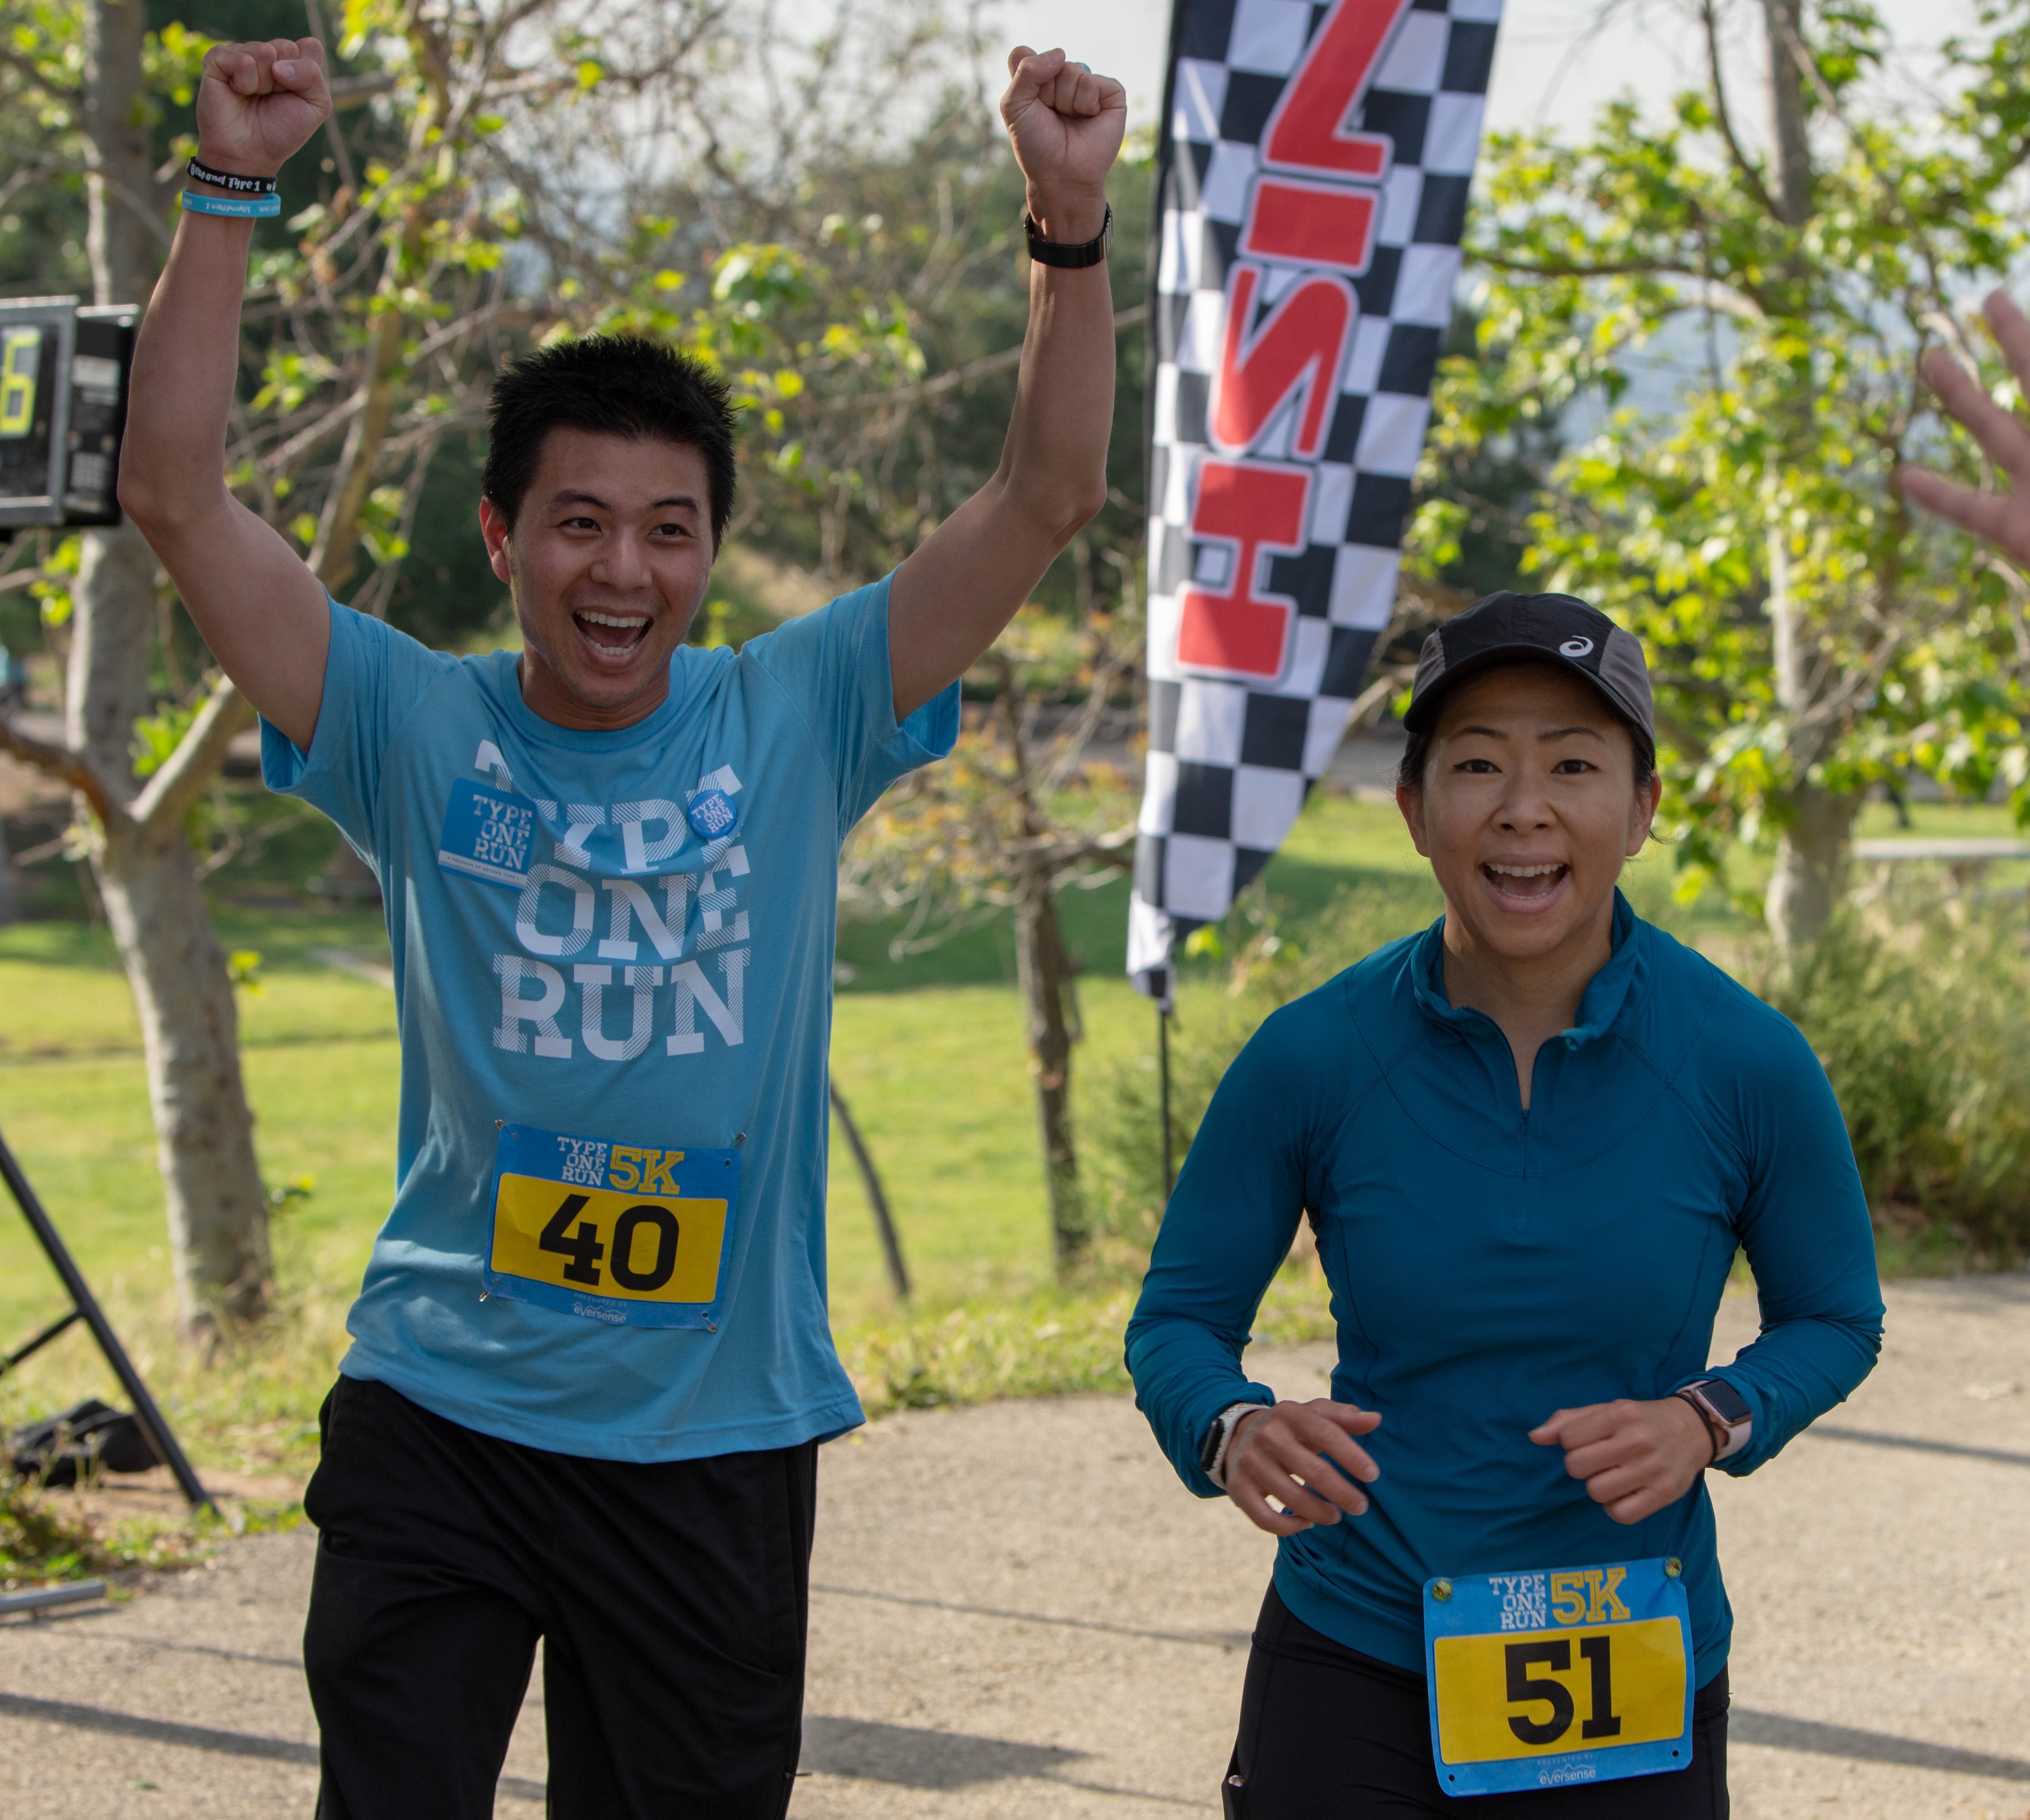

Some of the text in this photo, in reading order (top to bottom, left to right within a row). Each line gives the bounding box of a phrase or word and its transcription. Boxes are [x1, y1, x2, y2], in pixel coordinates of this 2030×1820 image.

[190, 163, 226, 185] Beyond
[228, 177, 253, 190] Type
[253, 181, 260, 192] 1
[473, 794, 532, 830] TYPE
[691, 794, 722, 819] TYPE
[704, 802, 728, 823] ONE
[708, 807, 734, 833] RUN
[481, 819, 530, 850] ONE
[473, 837, 525, 870] RUN
[515, 845, 751, 961] ONE
[493, 946, 751, 1061] RUN
[557, 1136, 607, 1158] TYPE
[561, 1166, 603, 1186] RUN
[566, 1153, 606, 1173] ONE
[609, 1144, 685, 1195] 5K
[539, 1193, 679, 1291] 40
[1489, 1574, 1545, 1596] TYPE
[1550, 1567, 1631, 1625] 5K
[1503, 1592, 1546, 1613] ONE
[1500, 1610, 1546, 1630] RUN
[1505, 1635, 1621, 1745] 51
